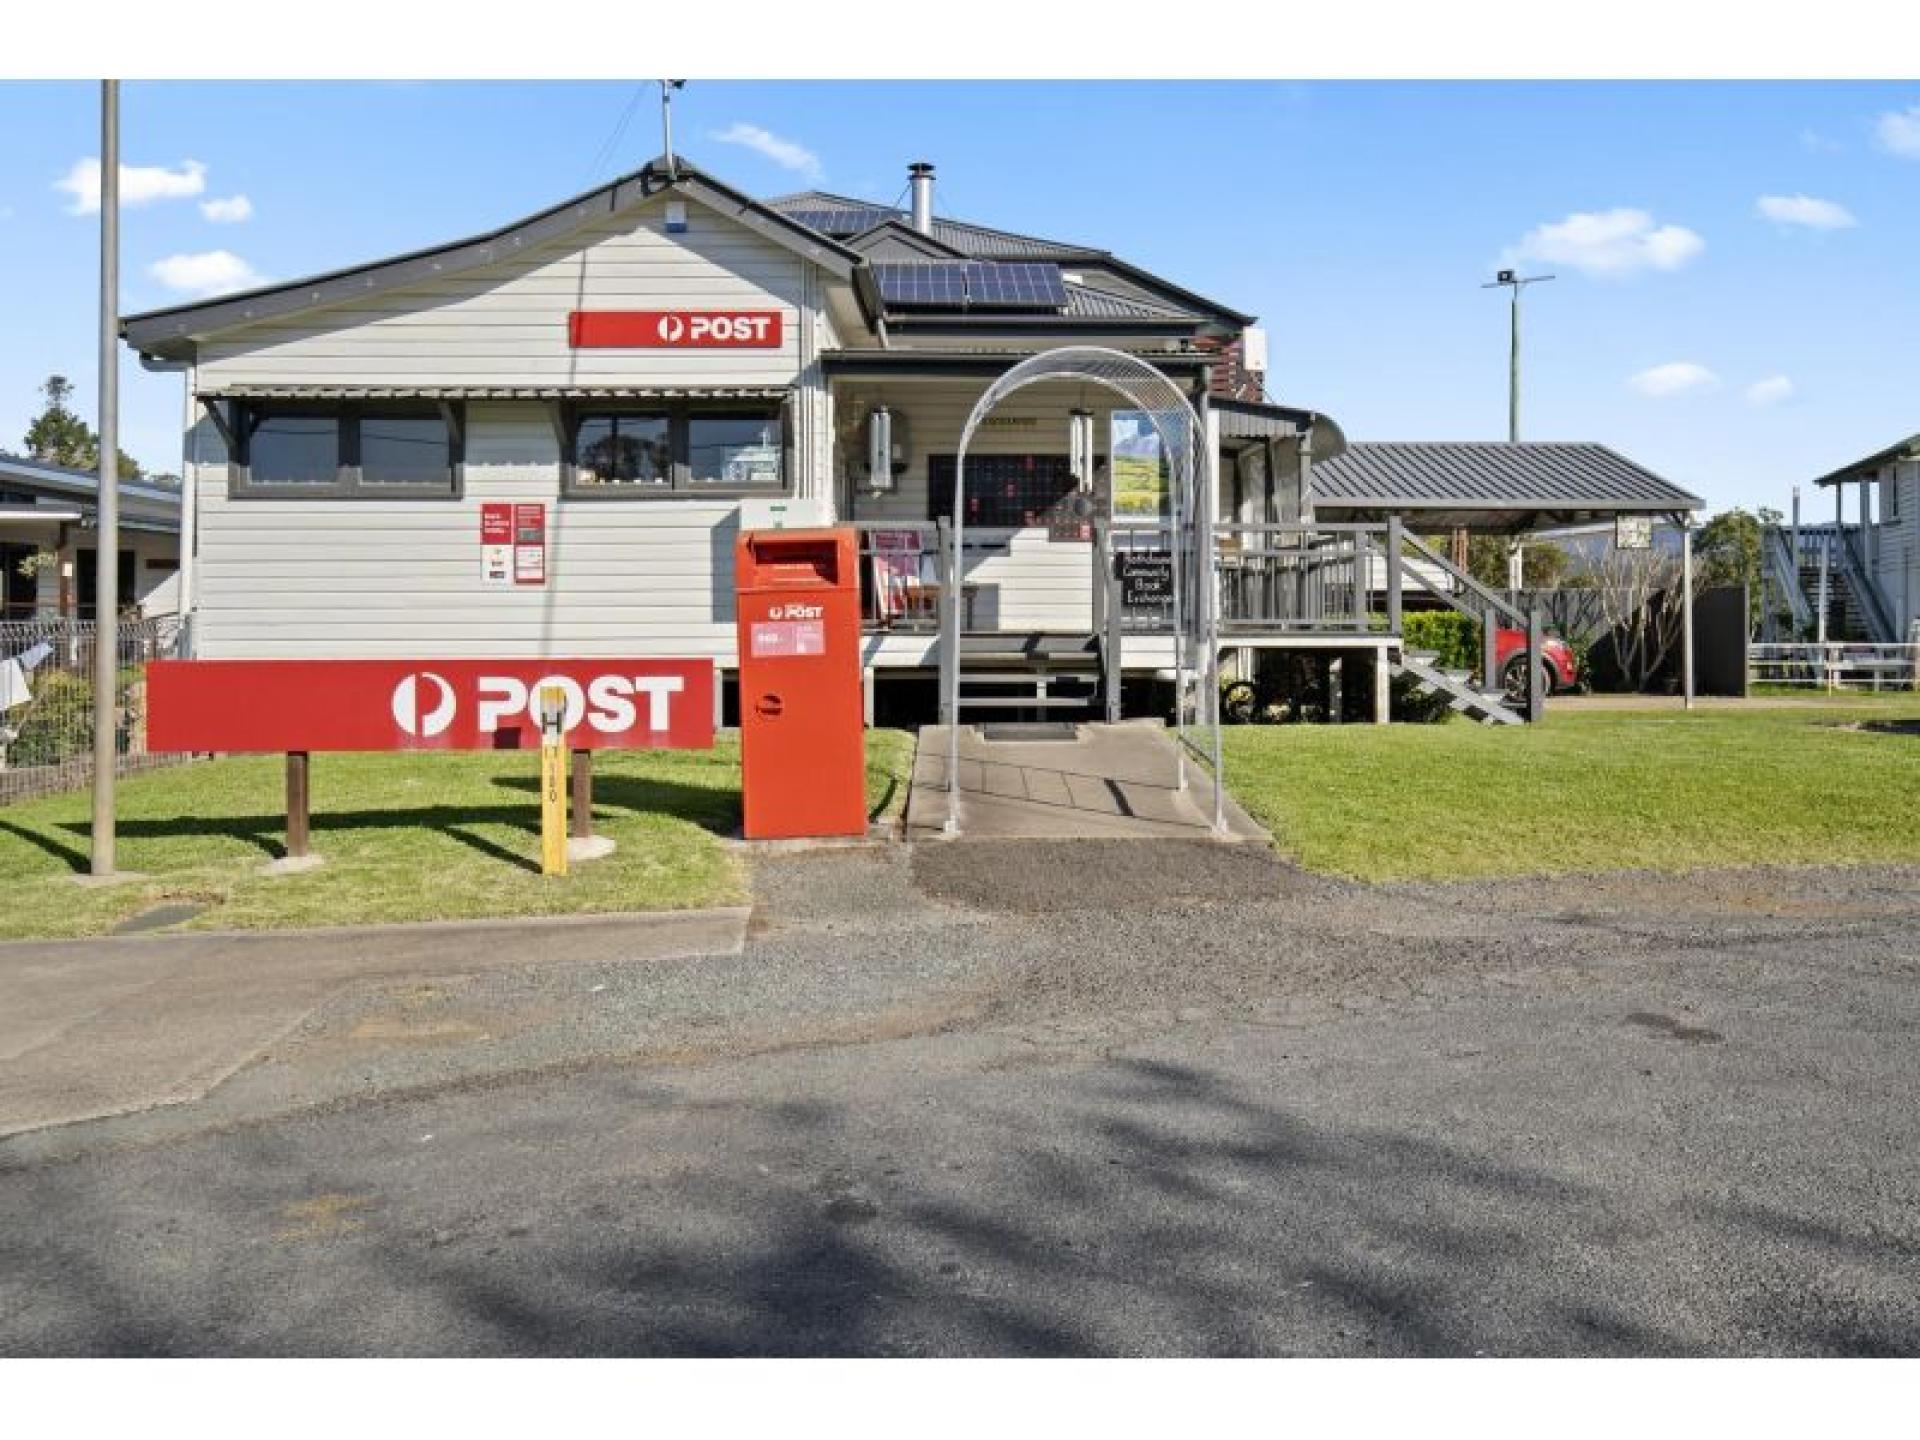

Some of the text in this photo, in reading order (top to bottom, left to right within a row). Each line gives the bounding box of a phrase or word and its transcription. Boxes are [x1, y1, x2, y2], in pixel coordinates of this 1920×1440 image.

[690, 316, 770, 341] POST
[785, 606, 823, 620] POST
[478, 675, 684, 732] POST
